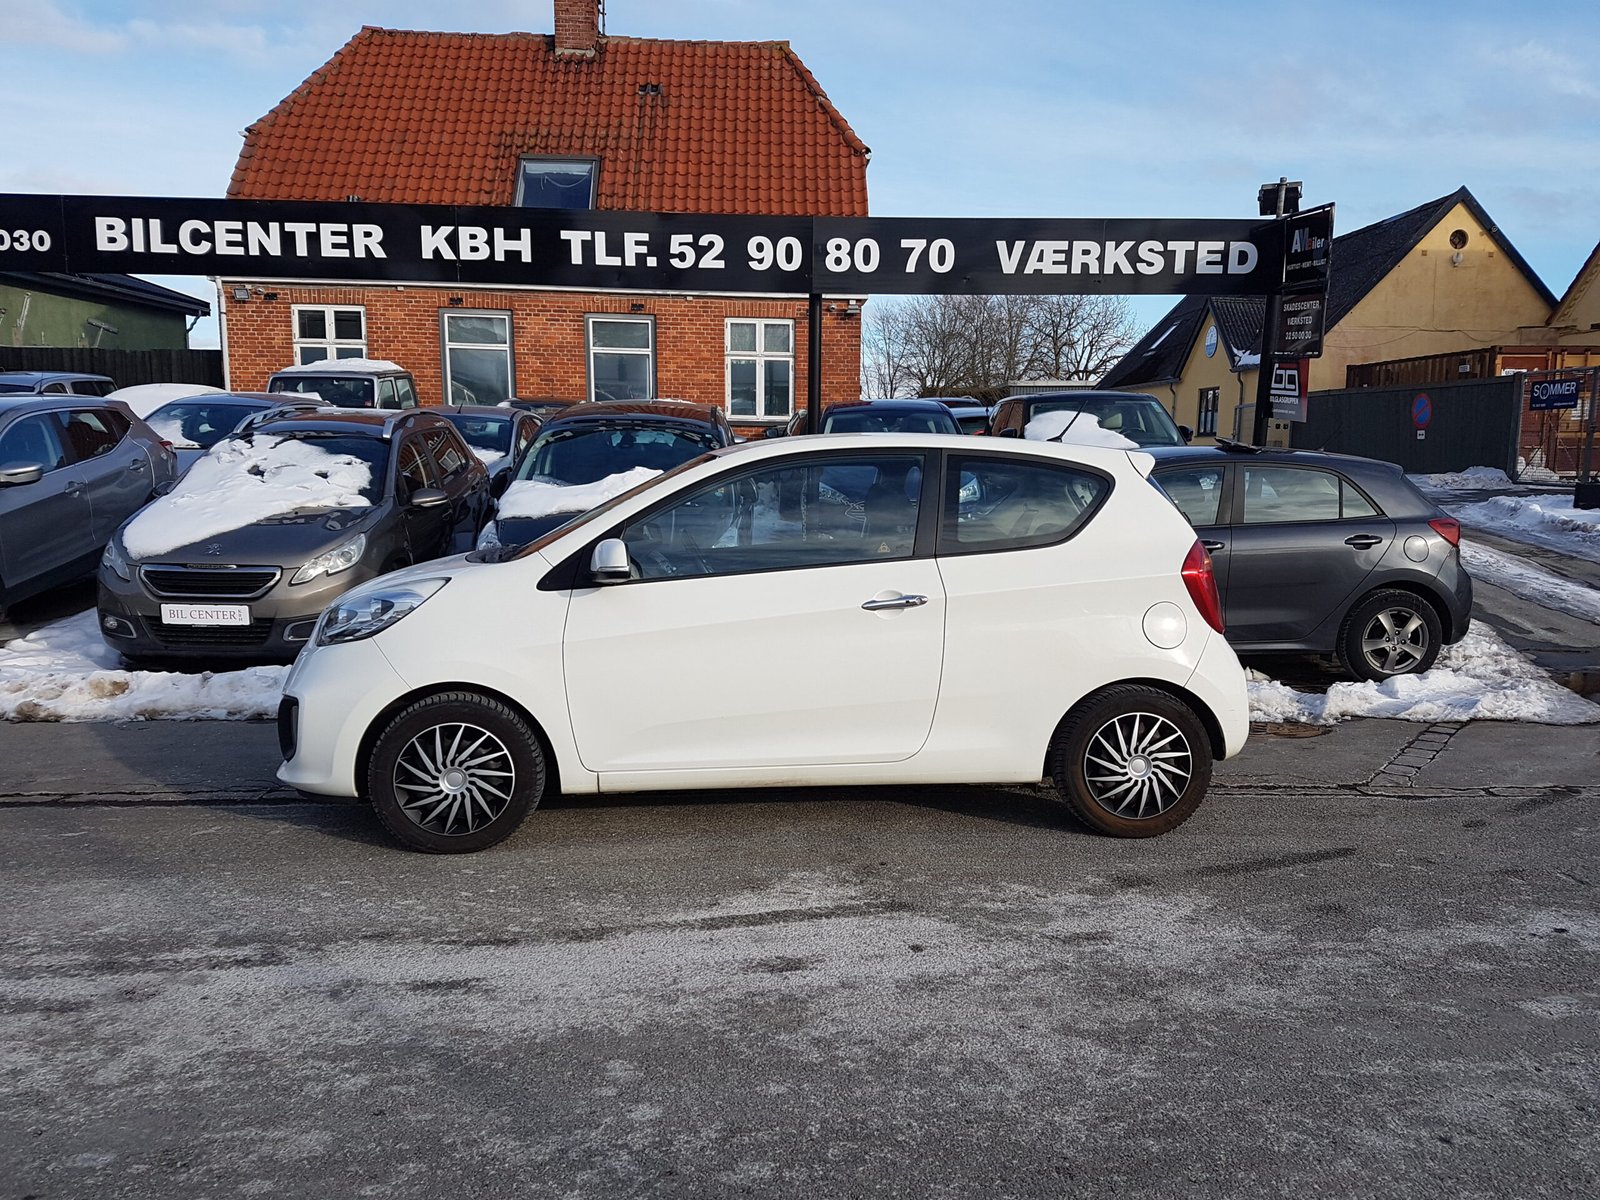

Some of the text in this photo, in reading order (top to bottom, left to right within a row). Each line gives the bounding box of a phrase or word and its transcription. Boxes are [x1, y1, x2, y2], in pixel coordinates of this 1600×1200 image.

[95, 216, 1258, 275] BILCENTER KBH TLF. 52 90 80 70 VÆRKSTED
[1533, 381, 1577, 400] SOMMER
[168, 609, 187, 619] BIL
[189, 610, 237, 621] CENTER
